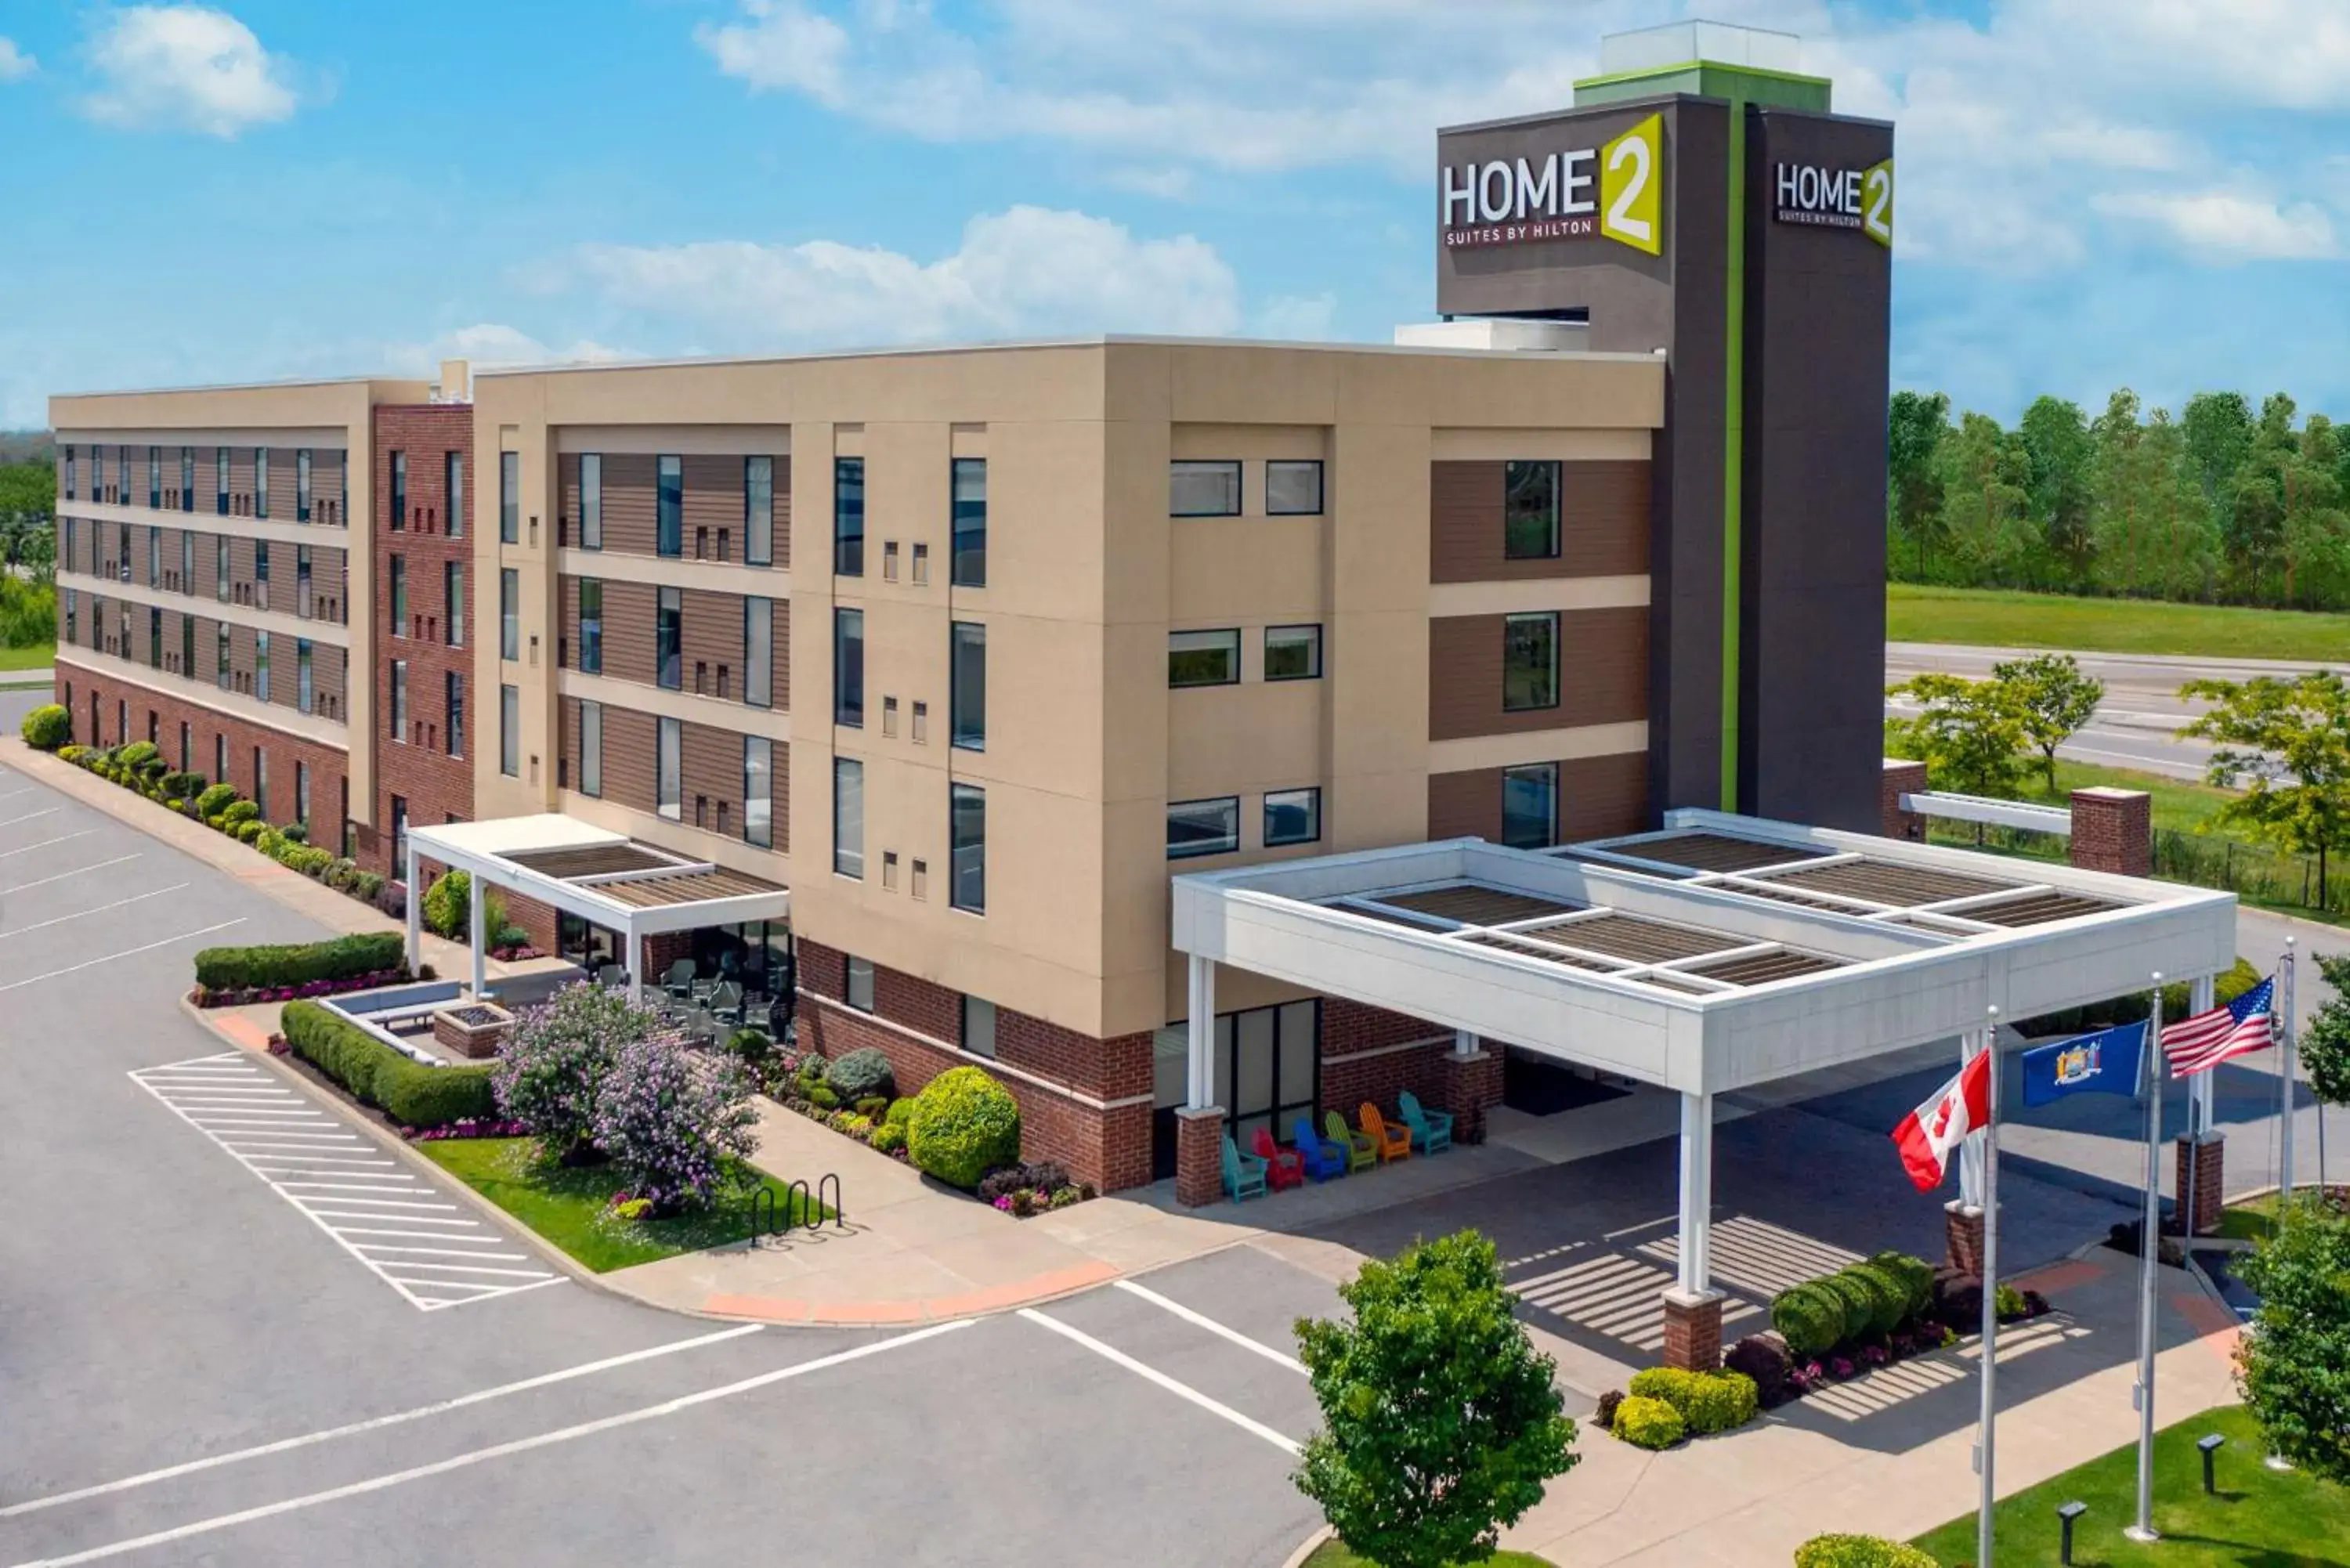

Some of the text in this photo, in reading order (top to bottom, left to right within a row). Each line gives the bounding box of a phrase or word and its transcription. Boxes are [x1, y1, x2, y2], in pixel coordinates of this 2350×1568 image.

[1444, 135, 1650, 241] HOME 2
[1777, 162, 1890, 239] HOME 2
[1446, 220, 1592, 245] SUITES BY HILTON
[1779, 210, 1861, 227] SUITES BY HILTON
